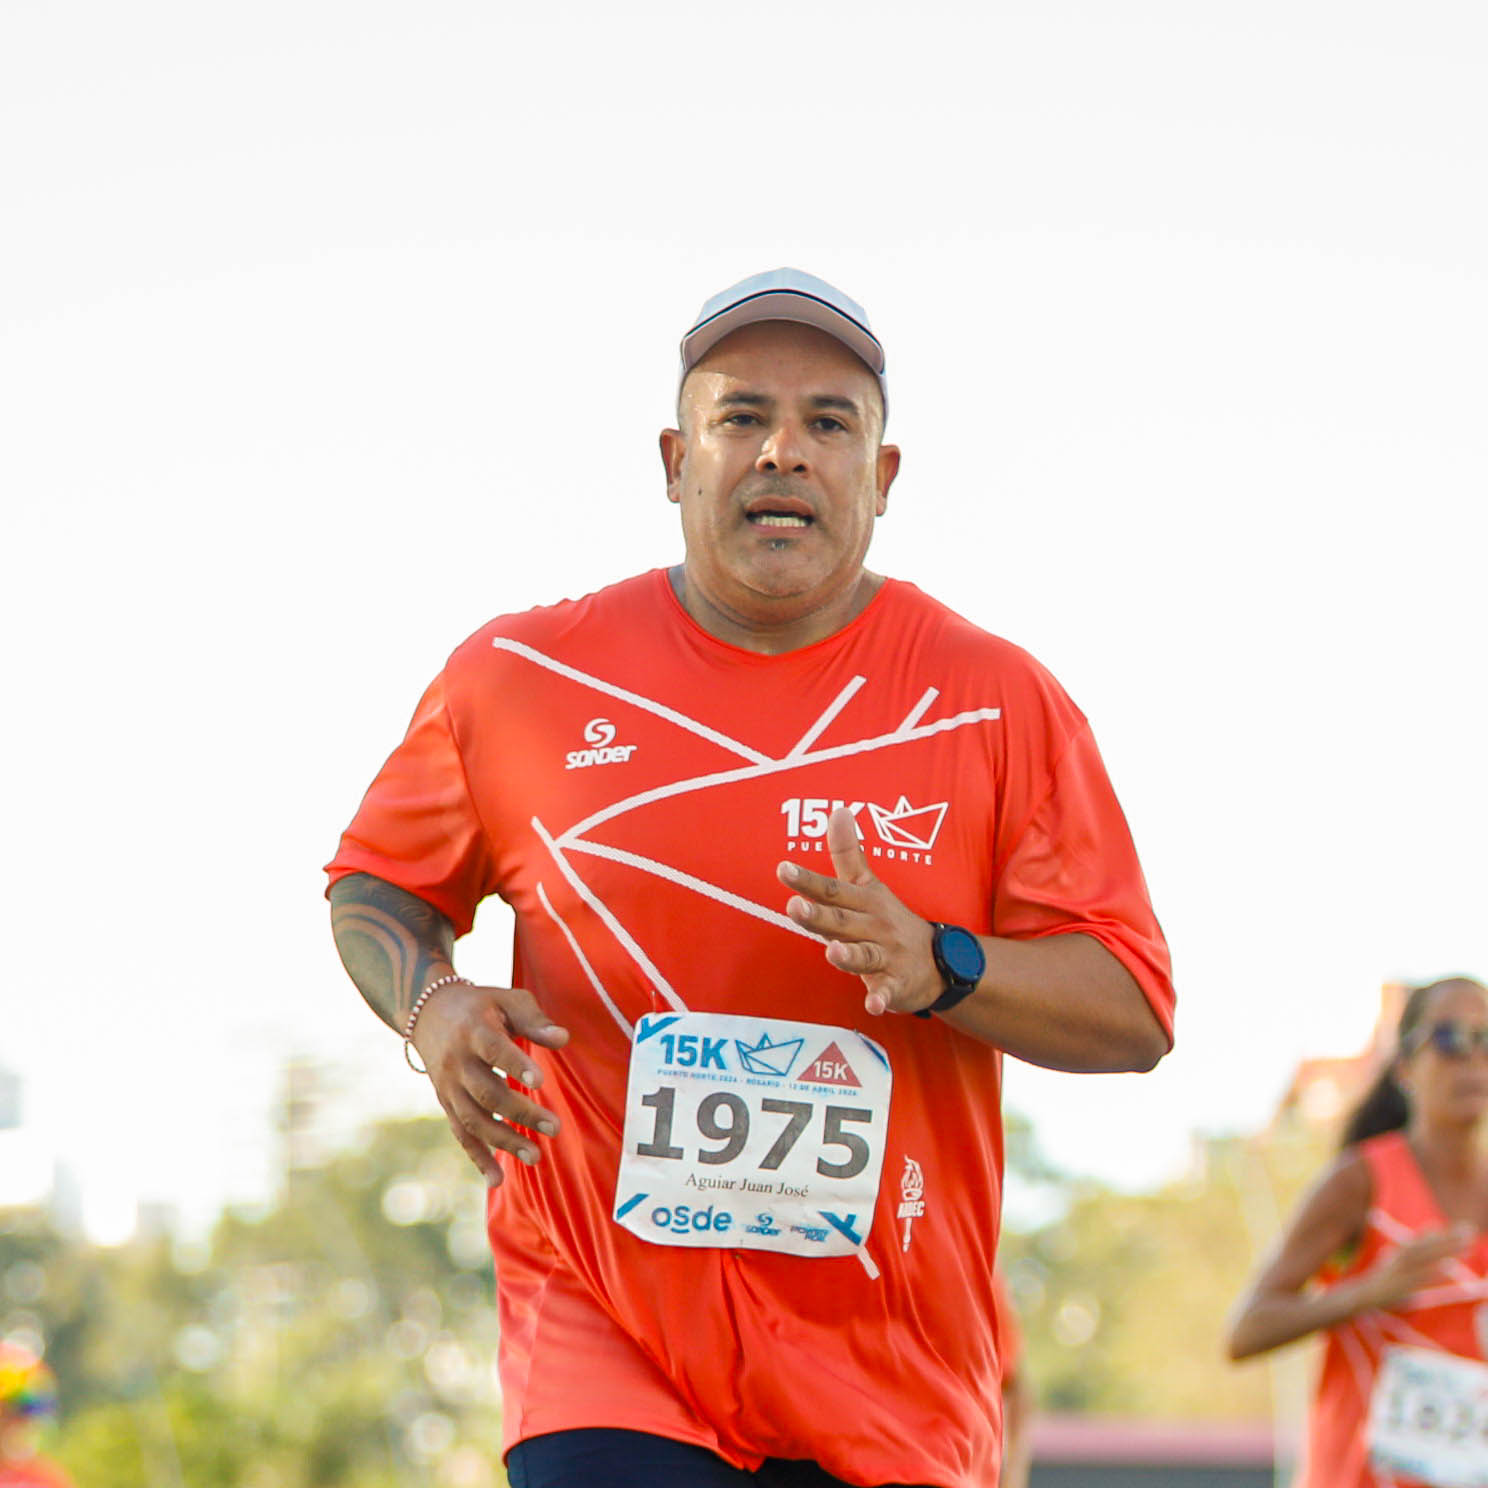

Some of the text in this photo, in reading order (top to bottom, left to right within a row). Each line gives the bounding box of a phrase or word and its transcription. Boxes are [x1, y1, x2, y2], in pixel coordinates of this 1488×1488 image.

[872, 847, 932, 865] NORTE
[660, 1033, 729, 1070] 15K
[813, 1060, 849, 1081] 15K
[636, 1086, 873, 1180] 1975
[685, 1172, 809, 1198] Aguiar Juan José
[651, 1204, 732, 1232] osde
